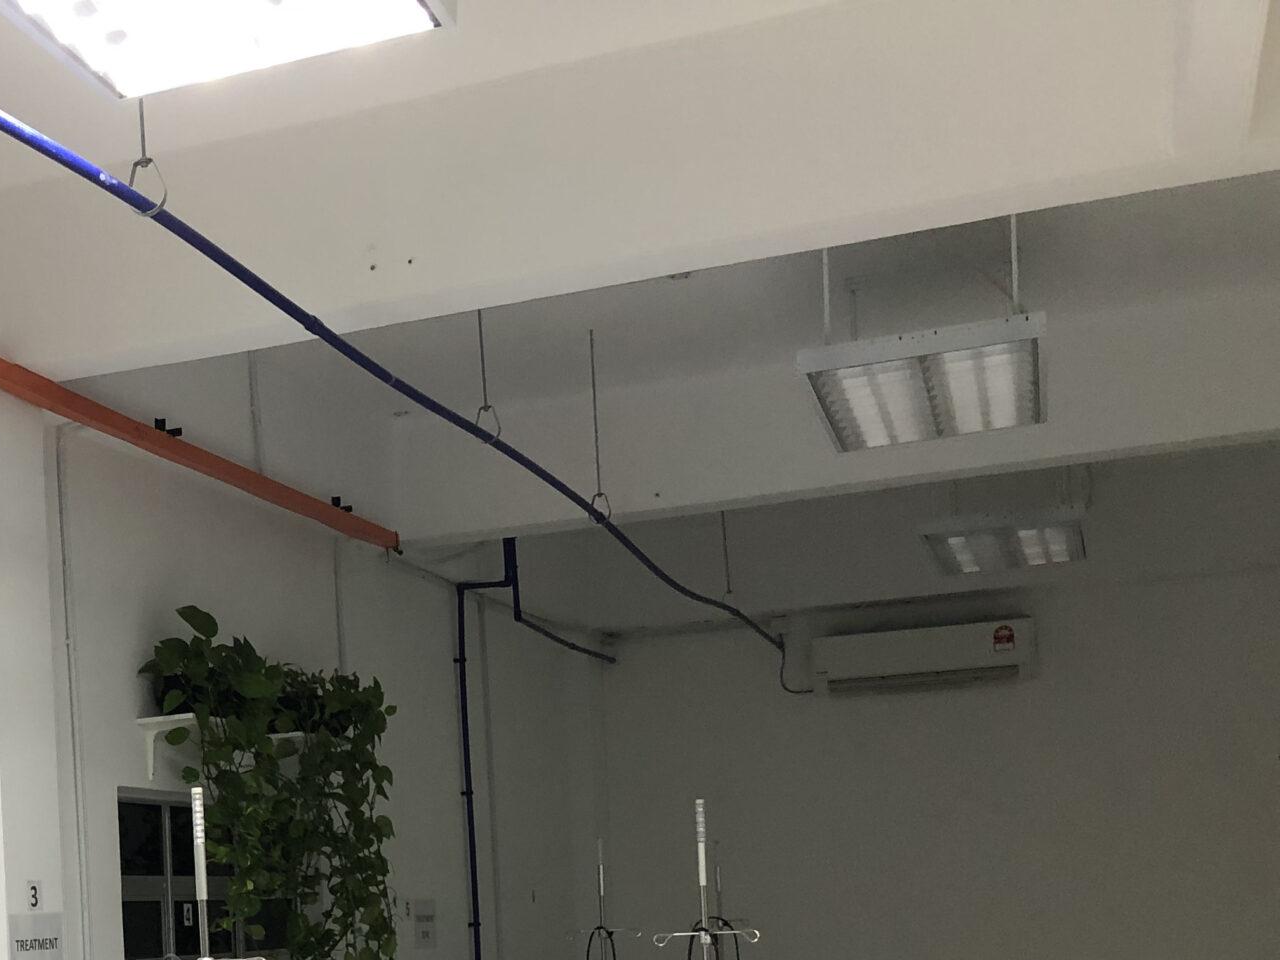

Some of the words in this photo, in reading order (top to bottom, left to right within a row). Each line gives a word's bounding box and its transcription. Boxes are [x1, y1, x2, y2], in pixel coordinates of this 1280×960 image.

[30, 885, 39, 908] 3
[185, 906, 191, 925] 4
[15, 937, 59, 952] TREATMENT
